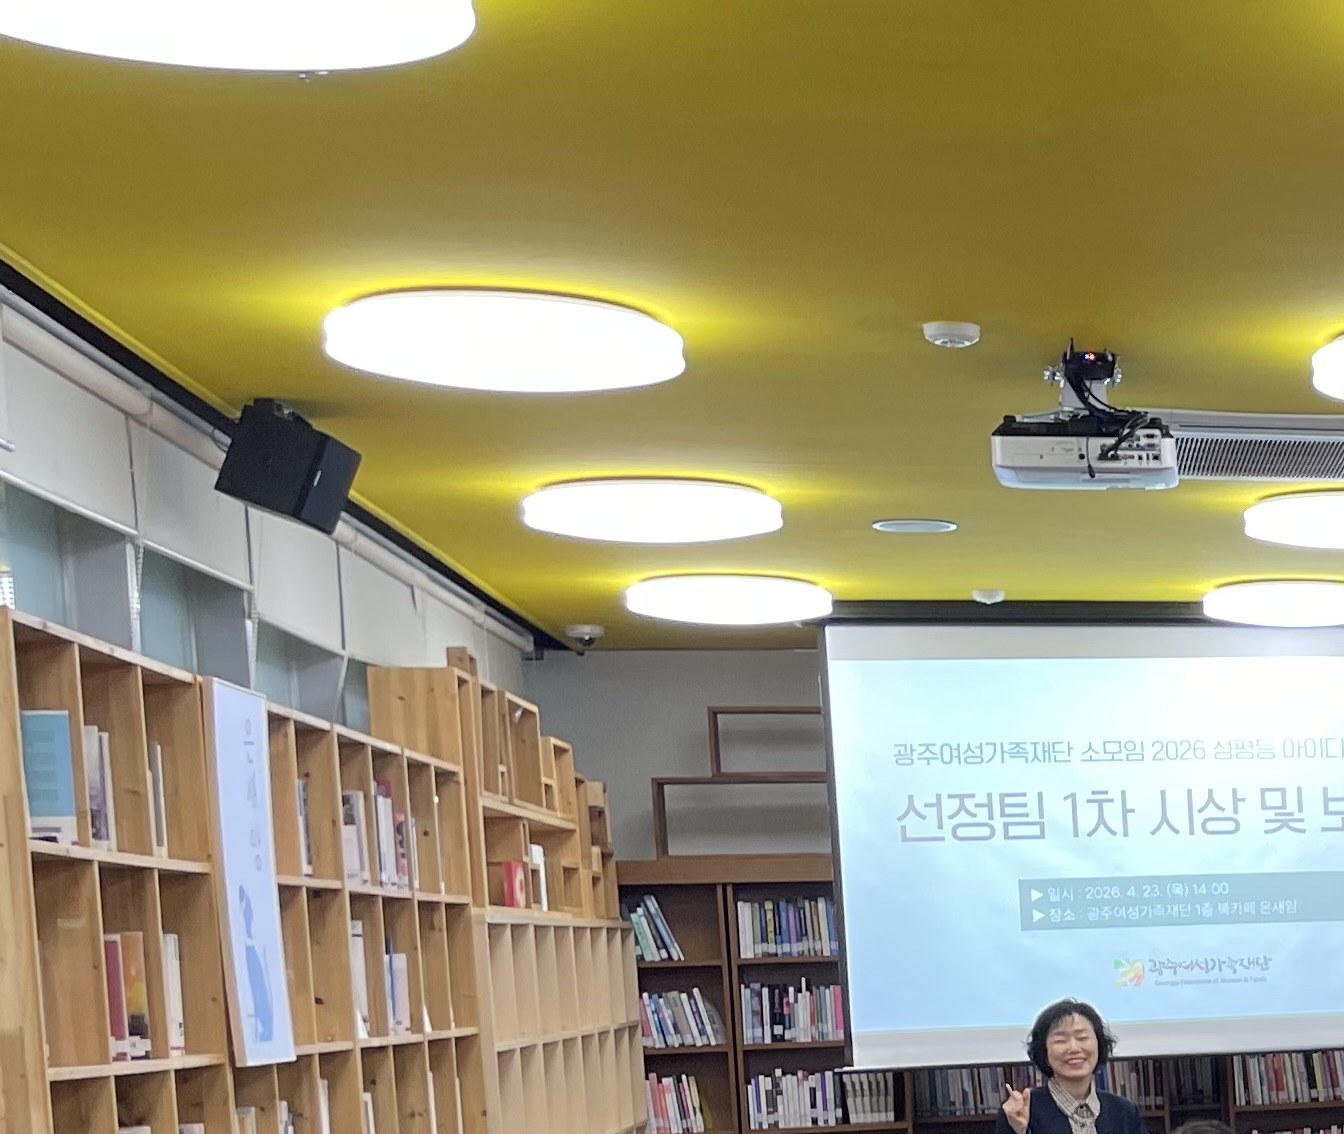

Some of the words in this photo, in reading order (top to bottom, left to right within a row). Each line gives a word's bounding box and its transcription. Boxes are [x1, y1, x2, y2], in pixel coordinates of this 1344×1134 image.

[893, 740, 1074, 766] 광주여성가족재단
[1079, 739, 1145, 762] 소모임
[1151, 740, 1206, 762] 2026
[1213, 737, 1276, 761] 성평등
[896, 791, 1047, 843] 선정팀
[1063, 789, 1136, 838] 1차
[1150, 786, 1246, 836] 시상
[1259, 786, 1307, 835] 및
[1047, 886, 1074, 902] 일시
[1192, 881, 1229, 896] 14:00
[1048, 907, 1076, 922] 장소
